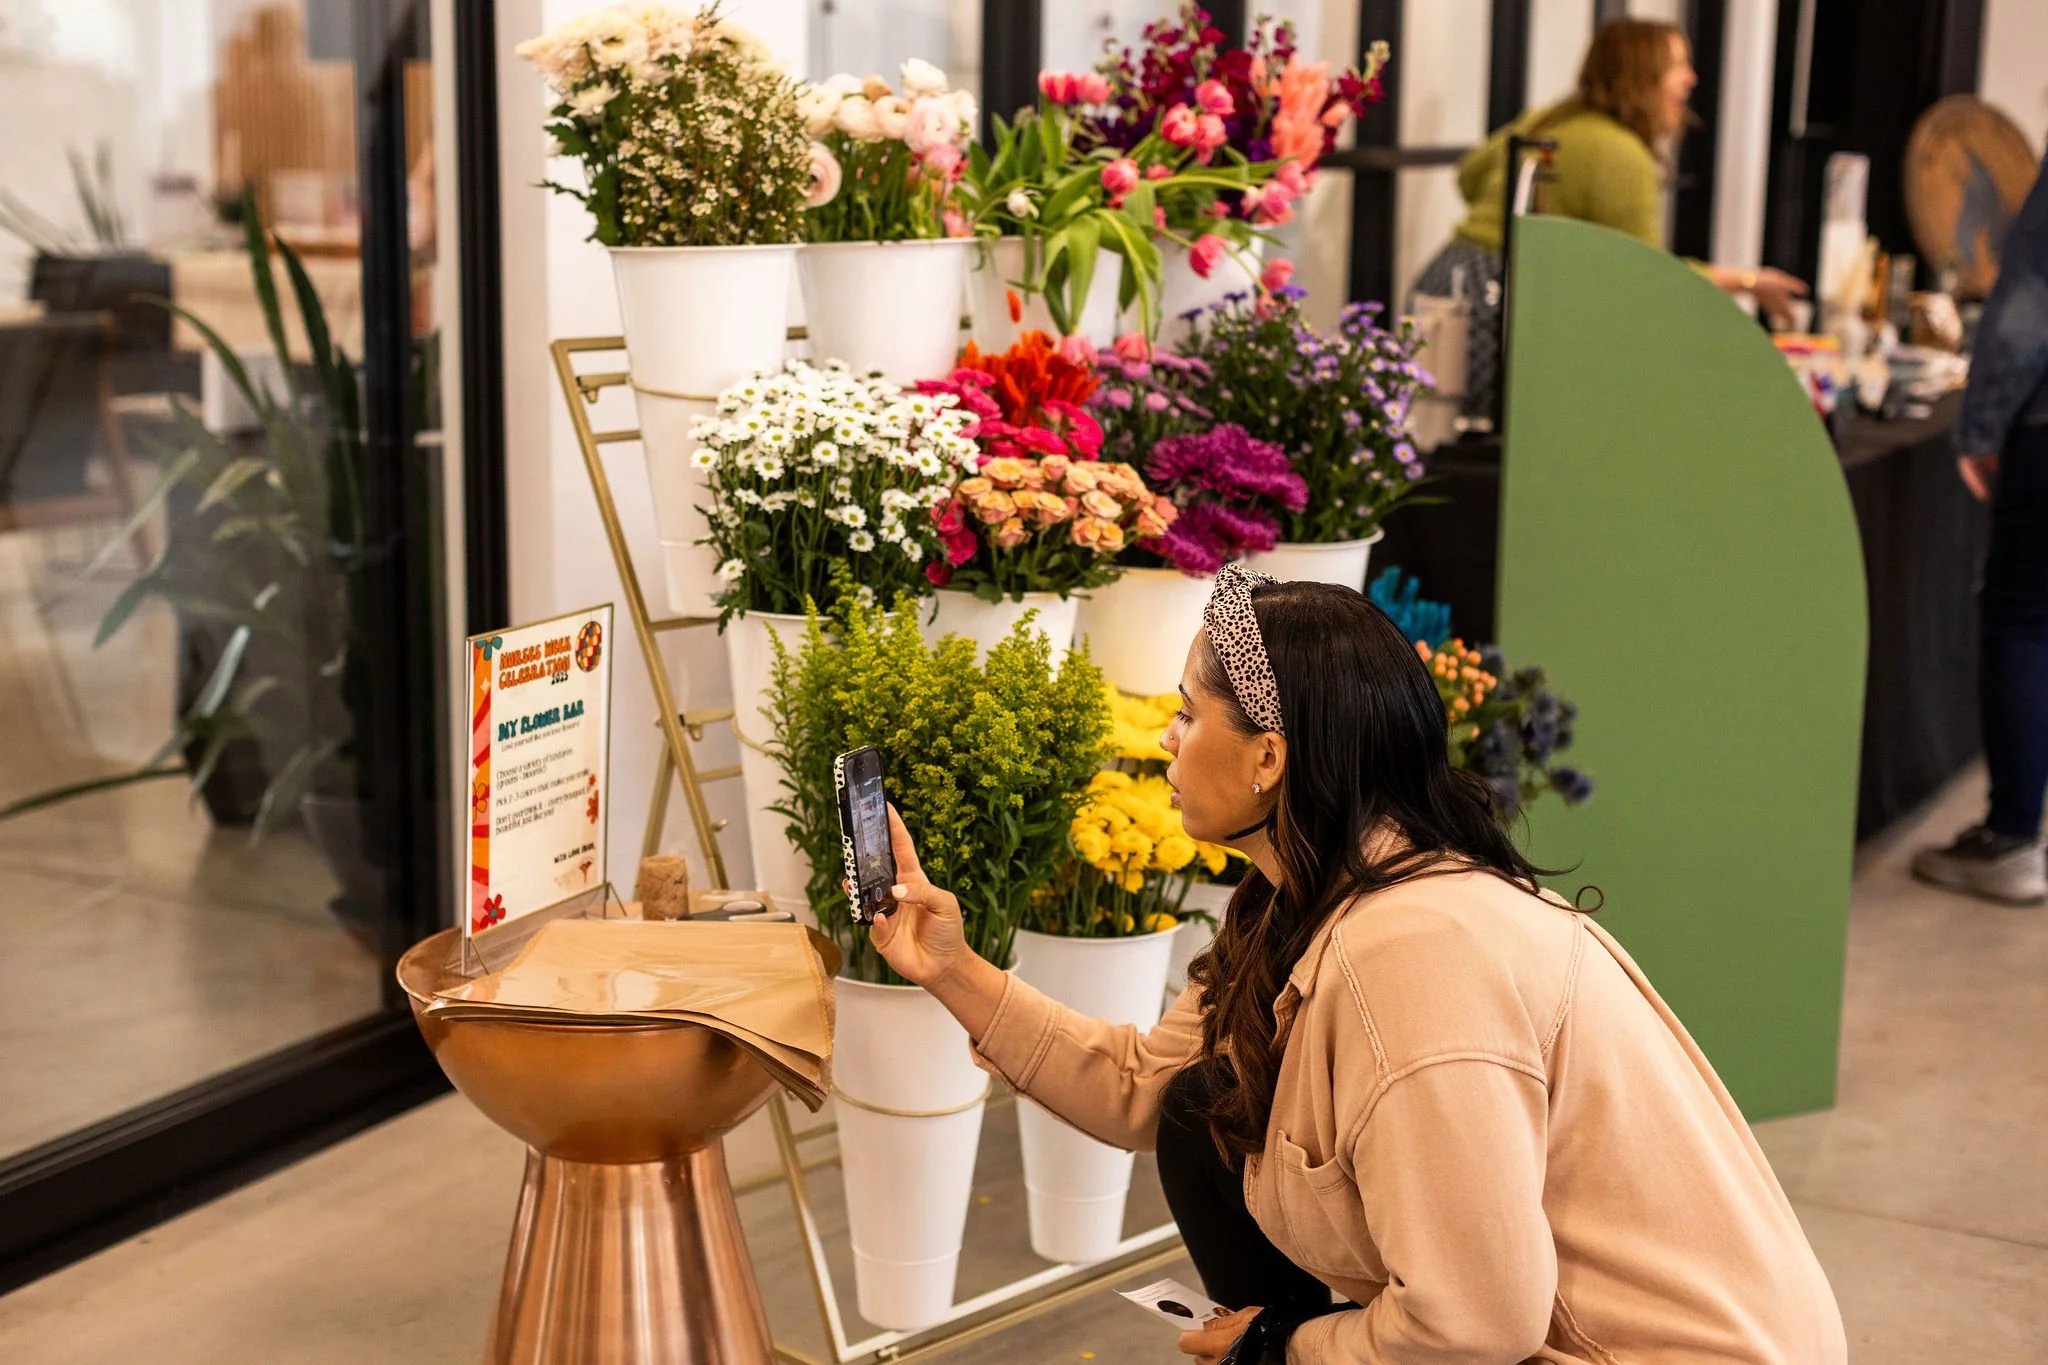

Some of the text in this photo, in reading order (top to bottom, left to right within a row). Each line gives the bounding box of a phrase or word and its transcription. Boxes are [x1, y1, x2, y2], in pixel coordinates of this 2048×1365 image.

[500, 635, 571, 670] NURSES WEEK
[499, 654, 571, 690] CELEBRATION
[498, 699, 584, 742] DIY FLOWER BAR
